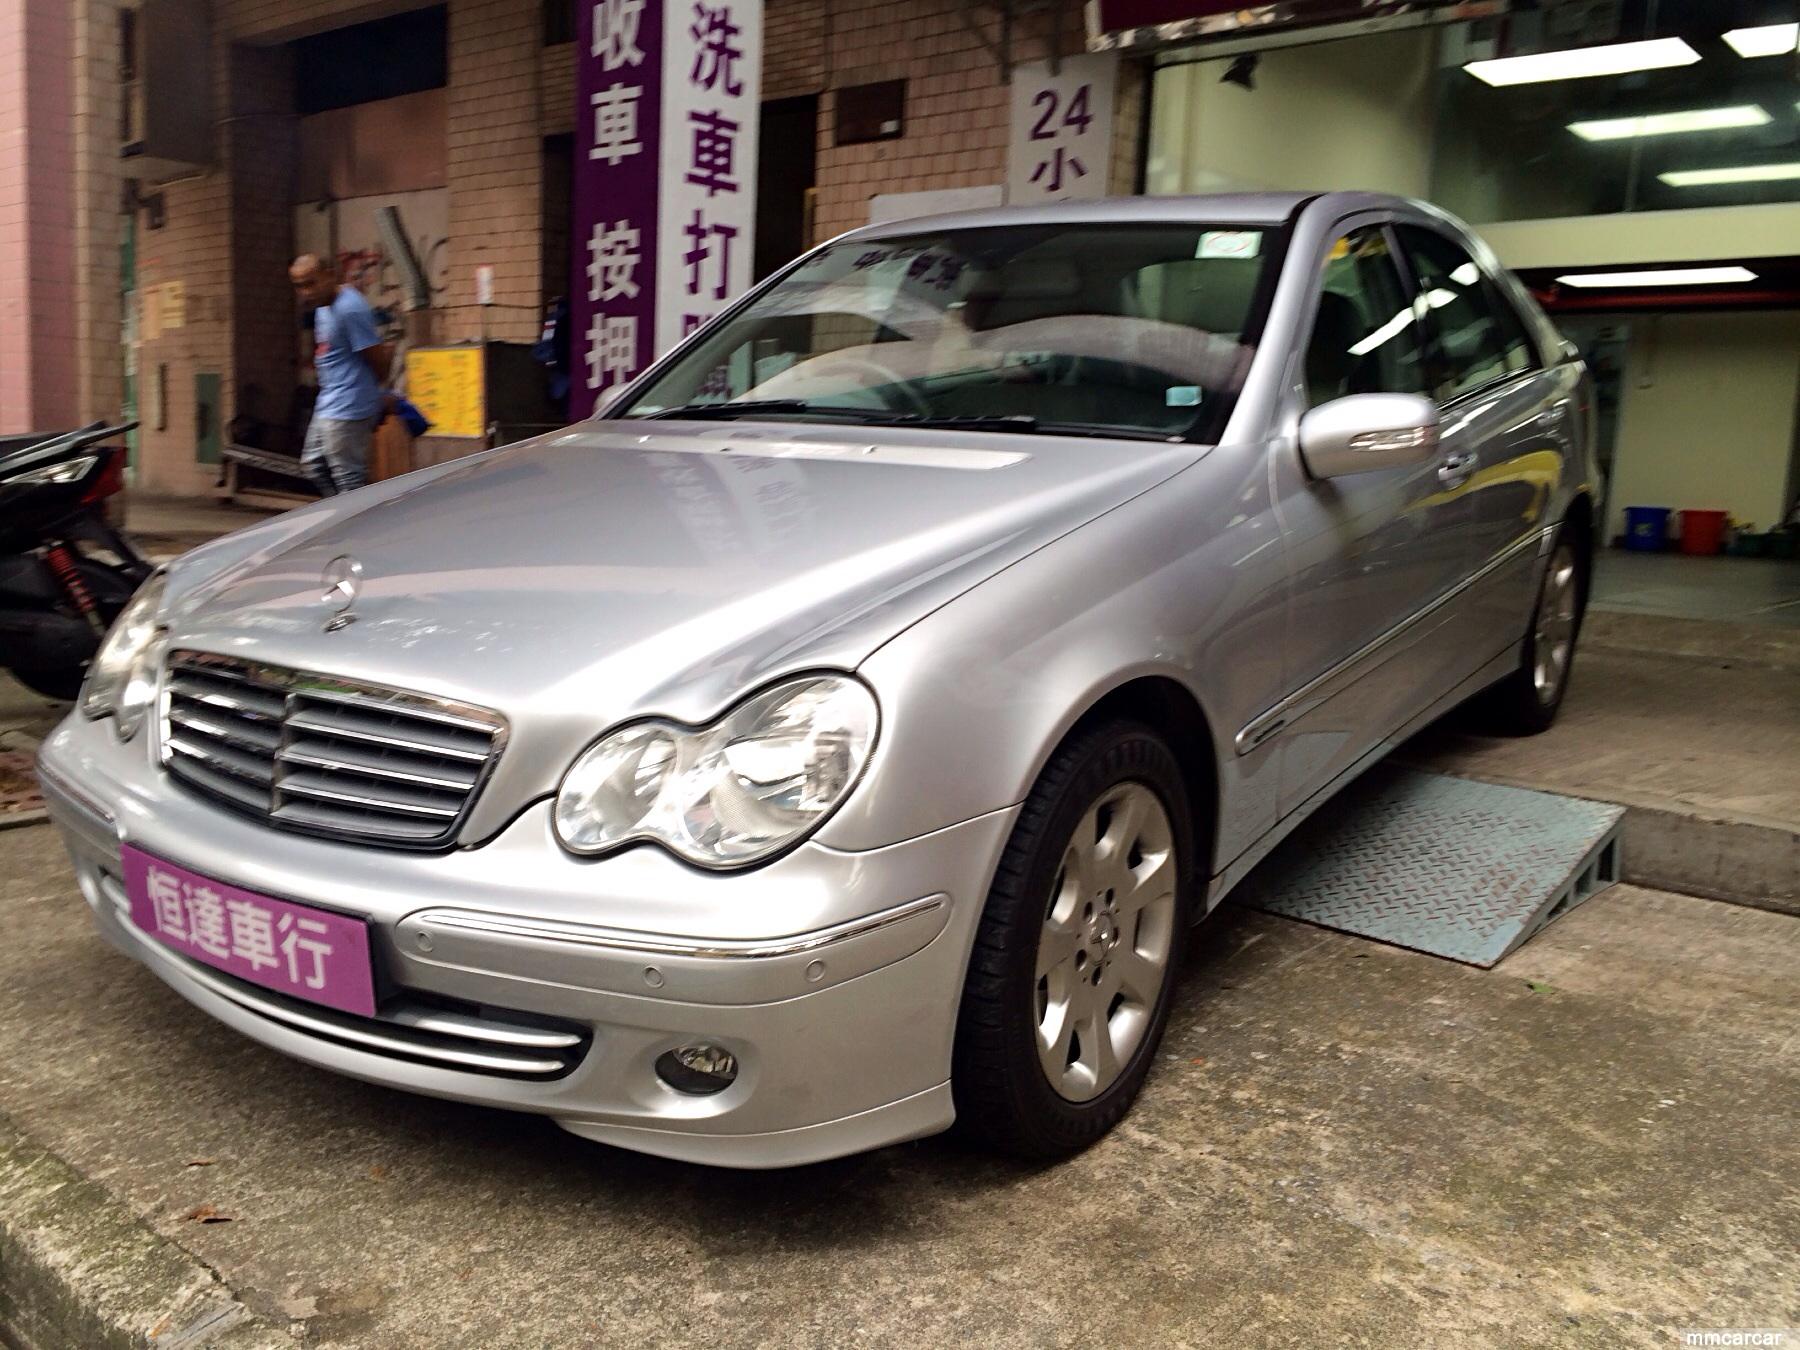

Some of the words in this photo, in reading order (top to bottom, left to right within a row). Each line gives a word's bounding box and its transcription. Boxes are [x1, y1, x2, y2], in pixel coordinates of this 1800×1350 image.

[588, 0, 646, 166] 收車
[683, 4, 742, 339] 洗車打
[584, 219, 641, 389] 按押
[146, 865, 333, 989] 恒達車行
